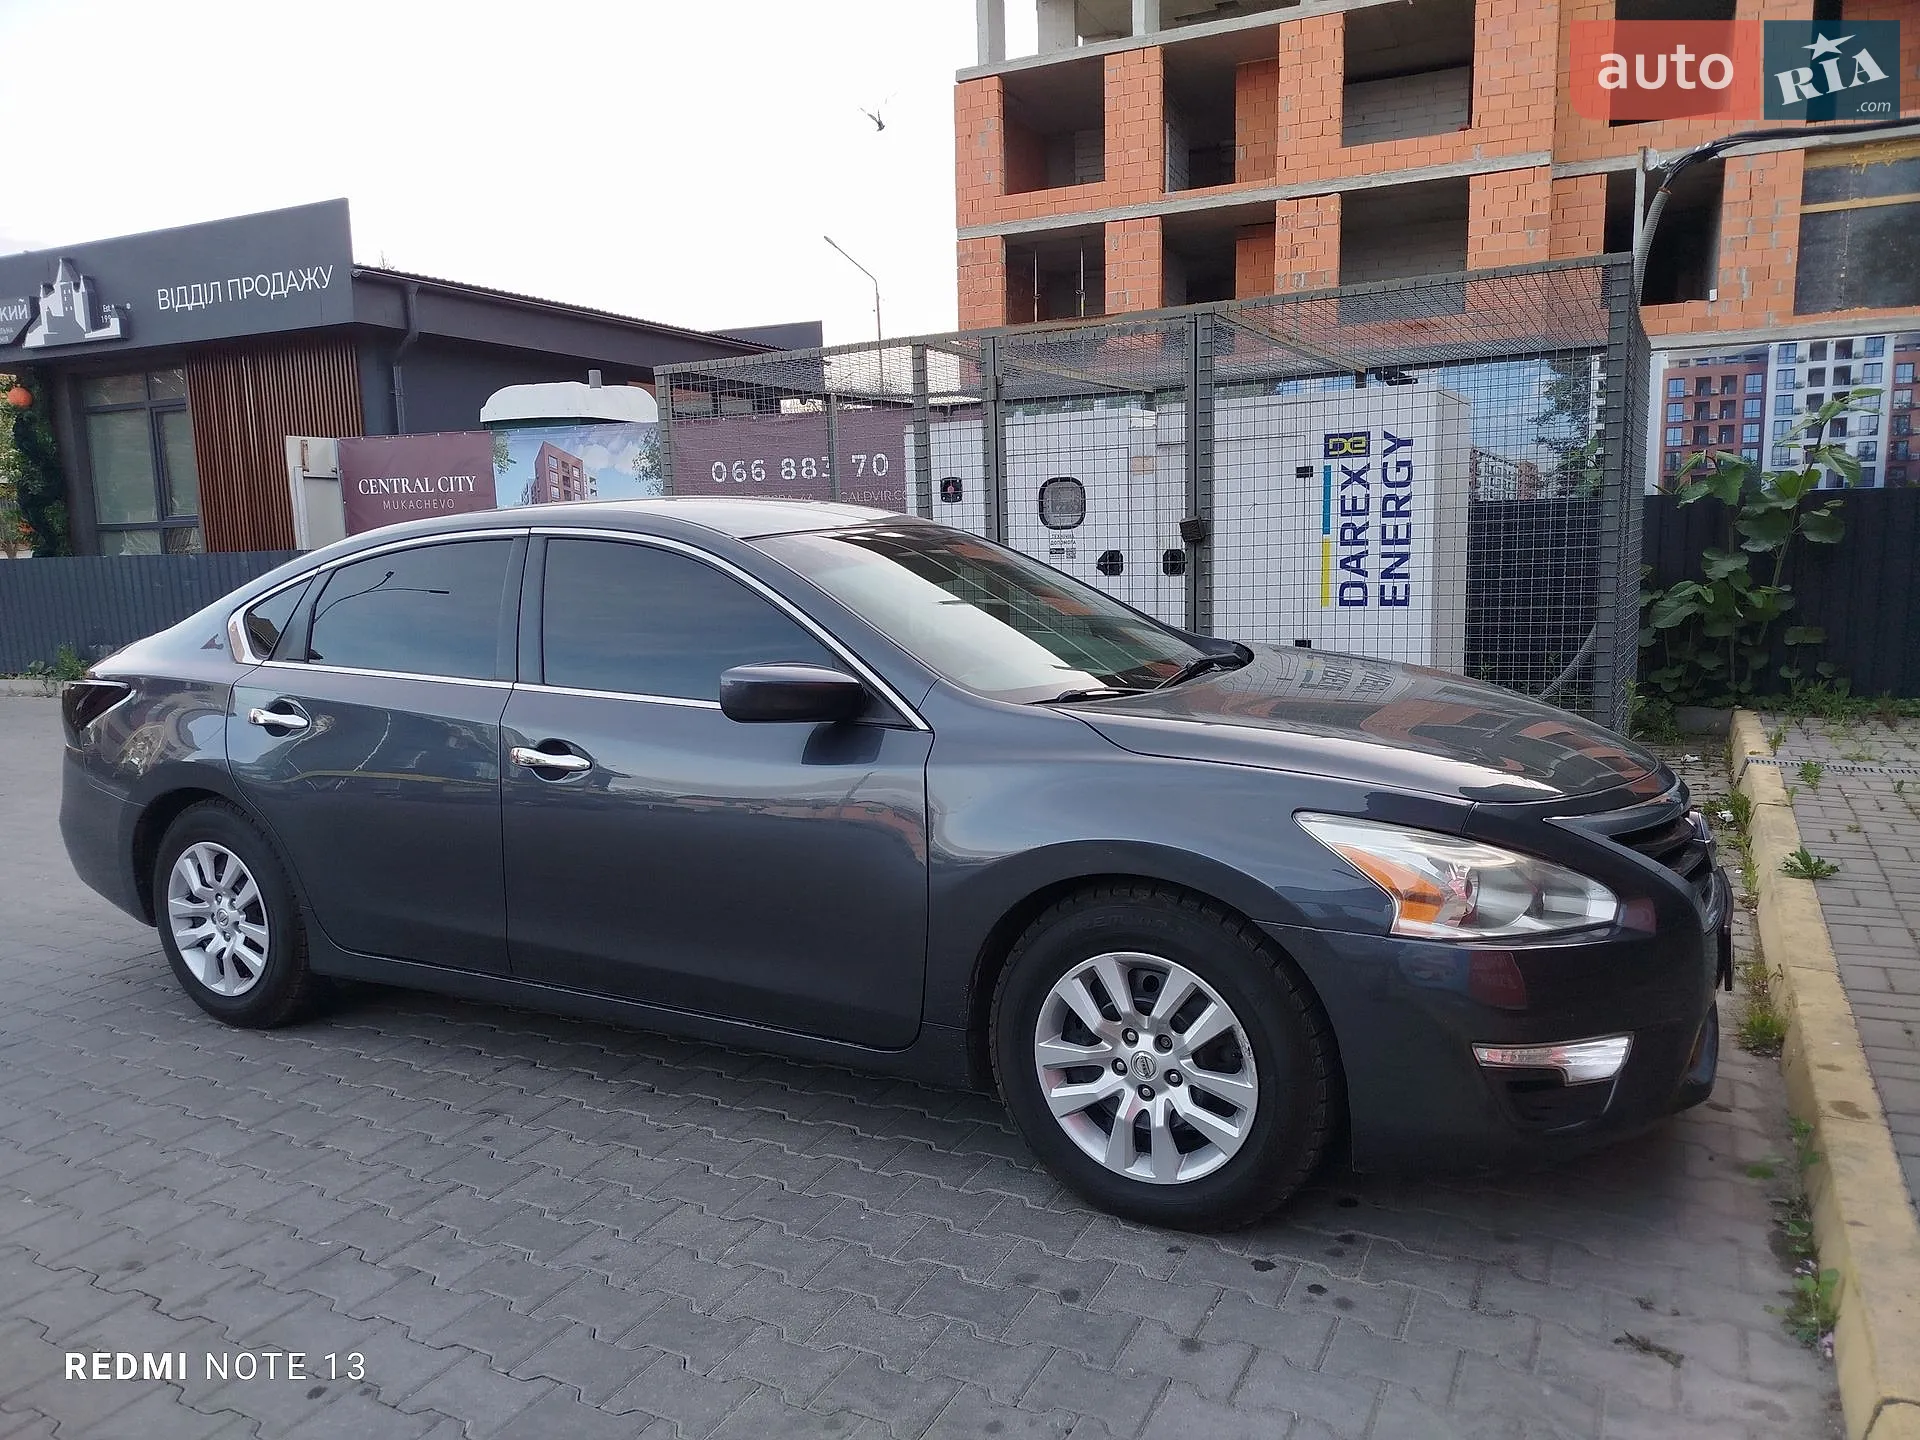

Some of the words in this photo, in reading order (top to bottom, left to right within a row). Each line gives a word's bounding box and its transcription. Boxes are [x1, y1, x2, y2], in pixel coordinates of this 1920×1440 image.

[157, 282, 222, 312] ВІДДІЛ
[227, 265, 333, 303] ПРОДАЖУ
[358, 477, 434, 494] CENTRAL
[437, 476, 476, 493] CITY
[711, 459, 766, 483] 066
[851, 453, 889, 477] 70
[383, 499, 455, 510] MUKACHEVO
[1380, 431, 1414, 607] ENERGY
[1339, 463, 1370, 607] DAREX
